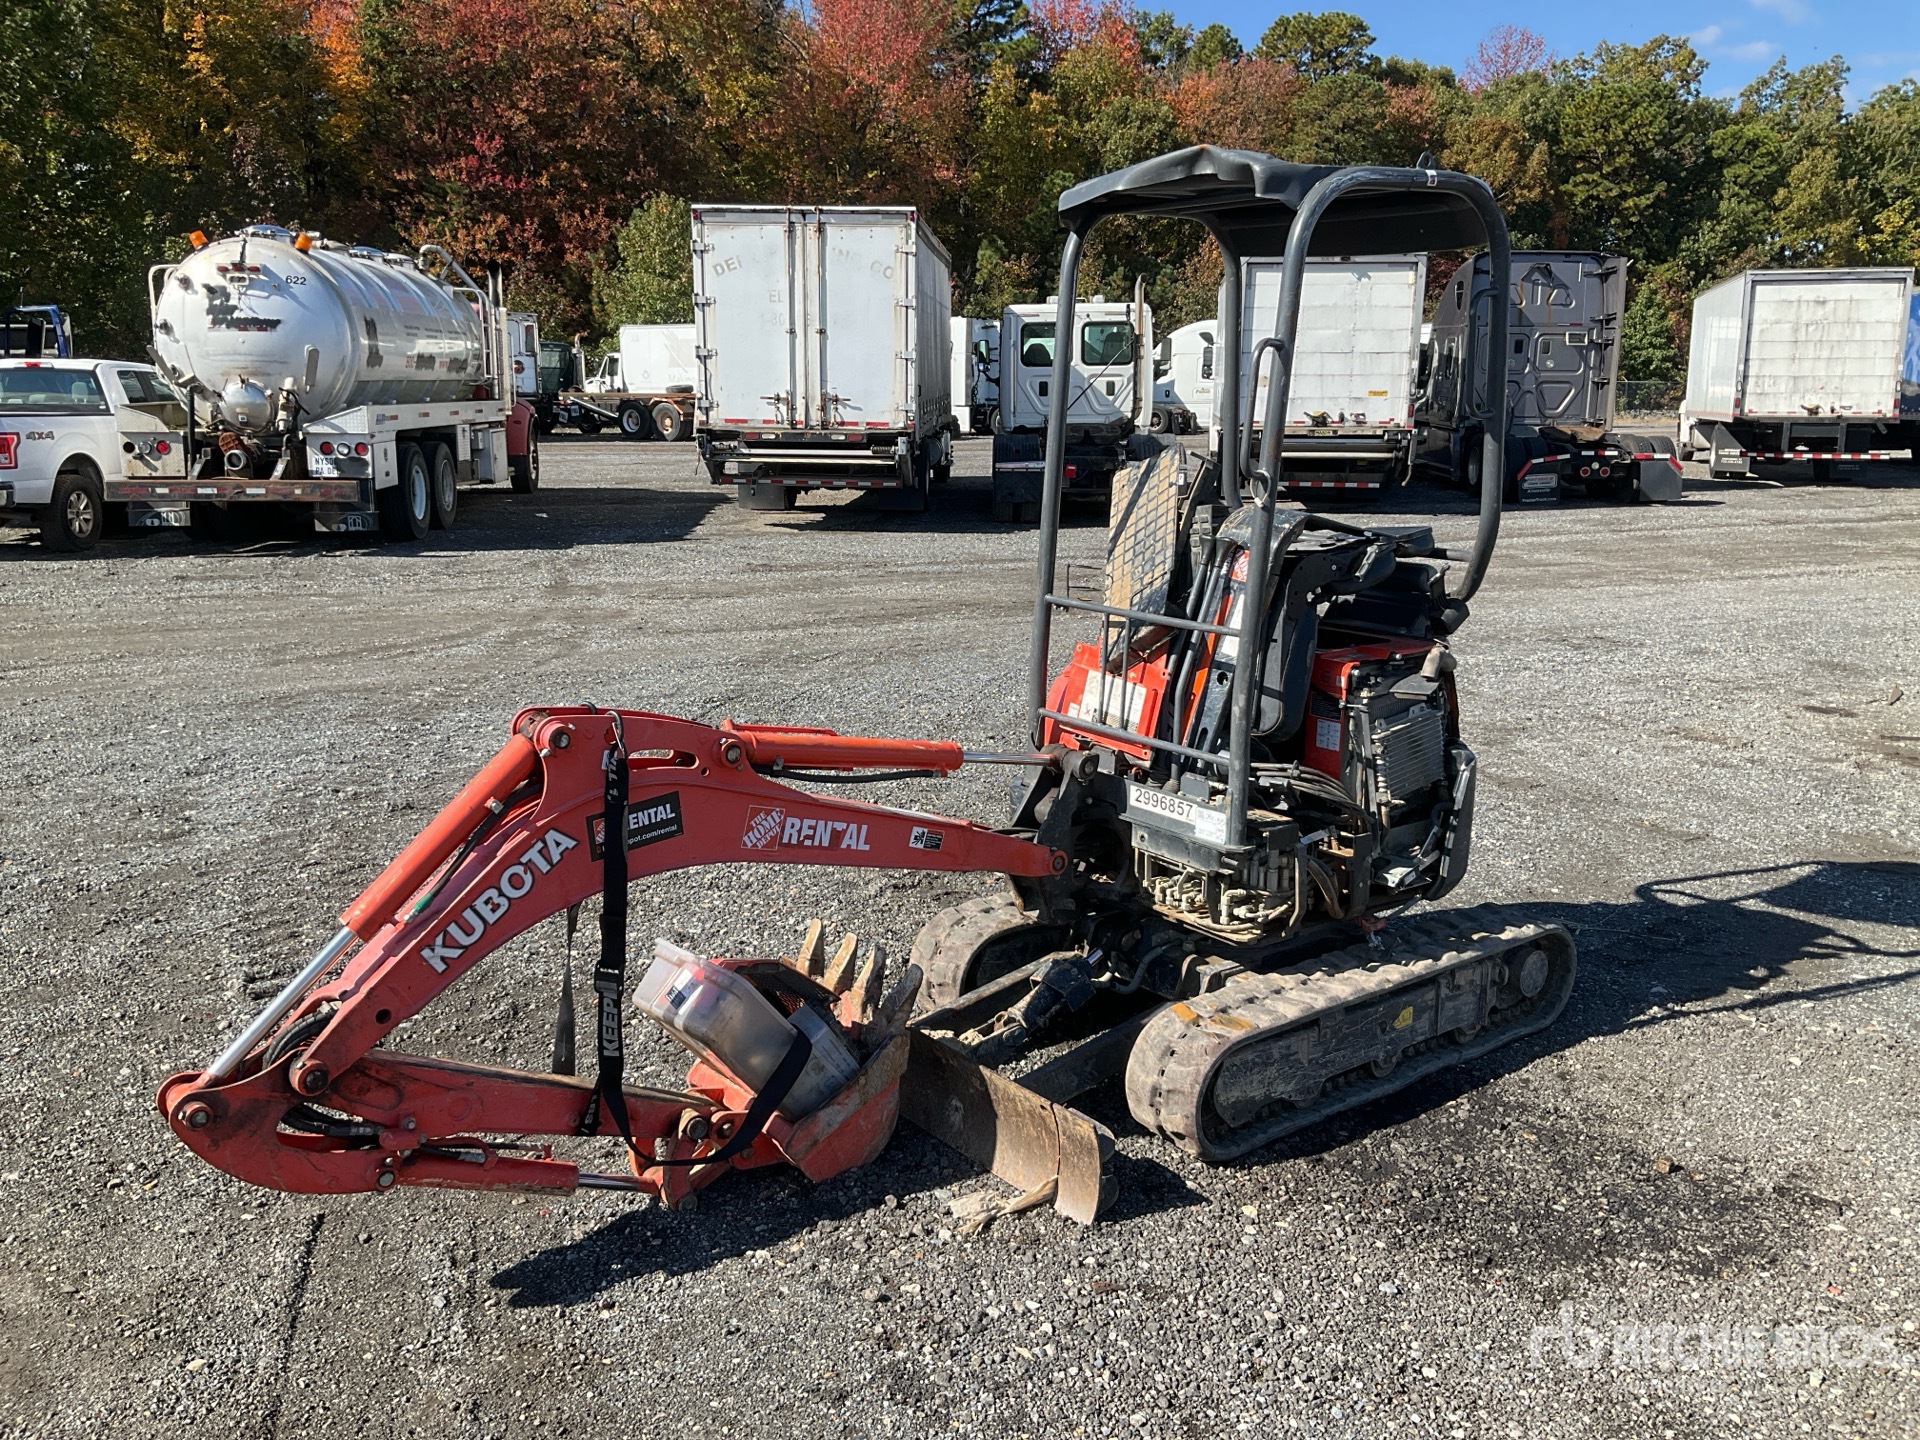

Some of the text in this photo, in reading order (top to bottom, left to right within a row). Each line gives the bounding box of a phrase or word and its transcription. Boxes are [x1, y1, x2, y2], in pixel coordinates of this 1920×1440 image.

[285, 275, 307, 285] 622
[627, 803, 676, 830] ENTAL
[1135, 788, 1193, 819] 2996857
[743, 808, 783, 848] HOME
[750, 810, 767, 827] THE
[627, 824, 678, 845] pot.com/rental
[756, 825, 781, 849] DEPOT
[782, 816, 871, 850] RENTAL
[420, 829, 579, 974] KUBOTA
